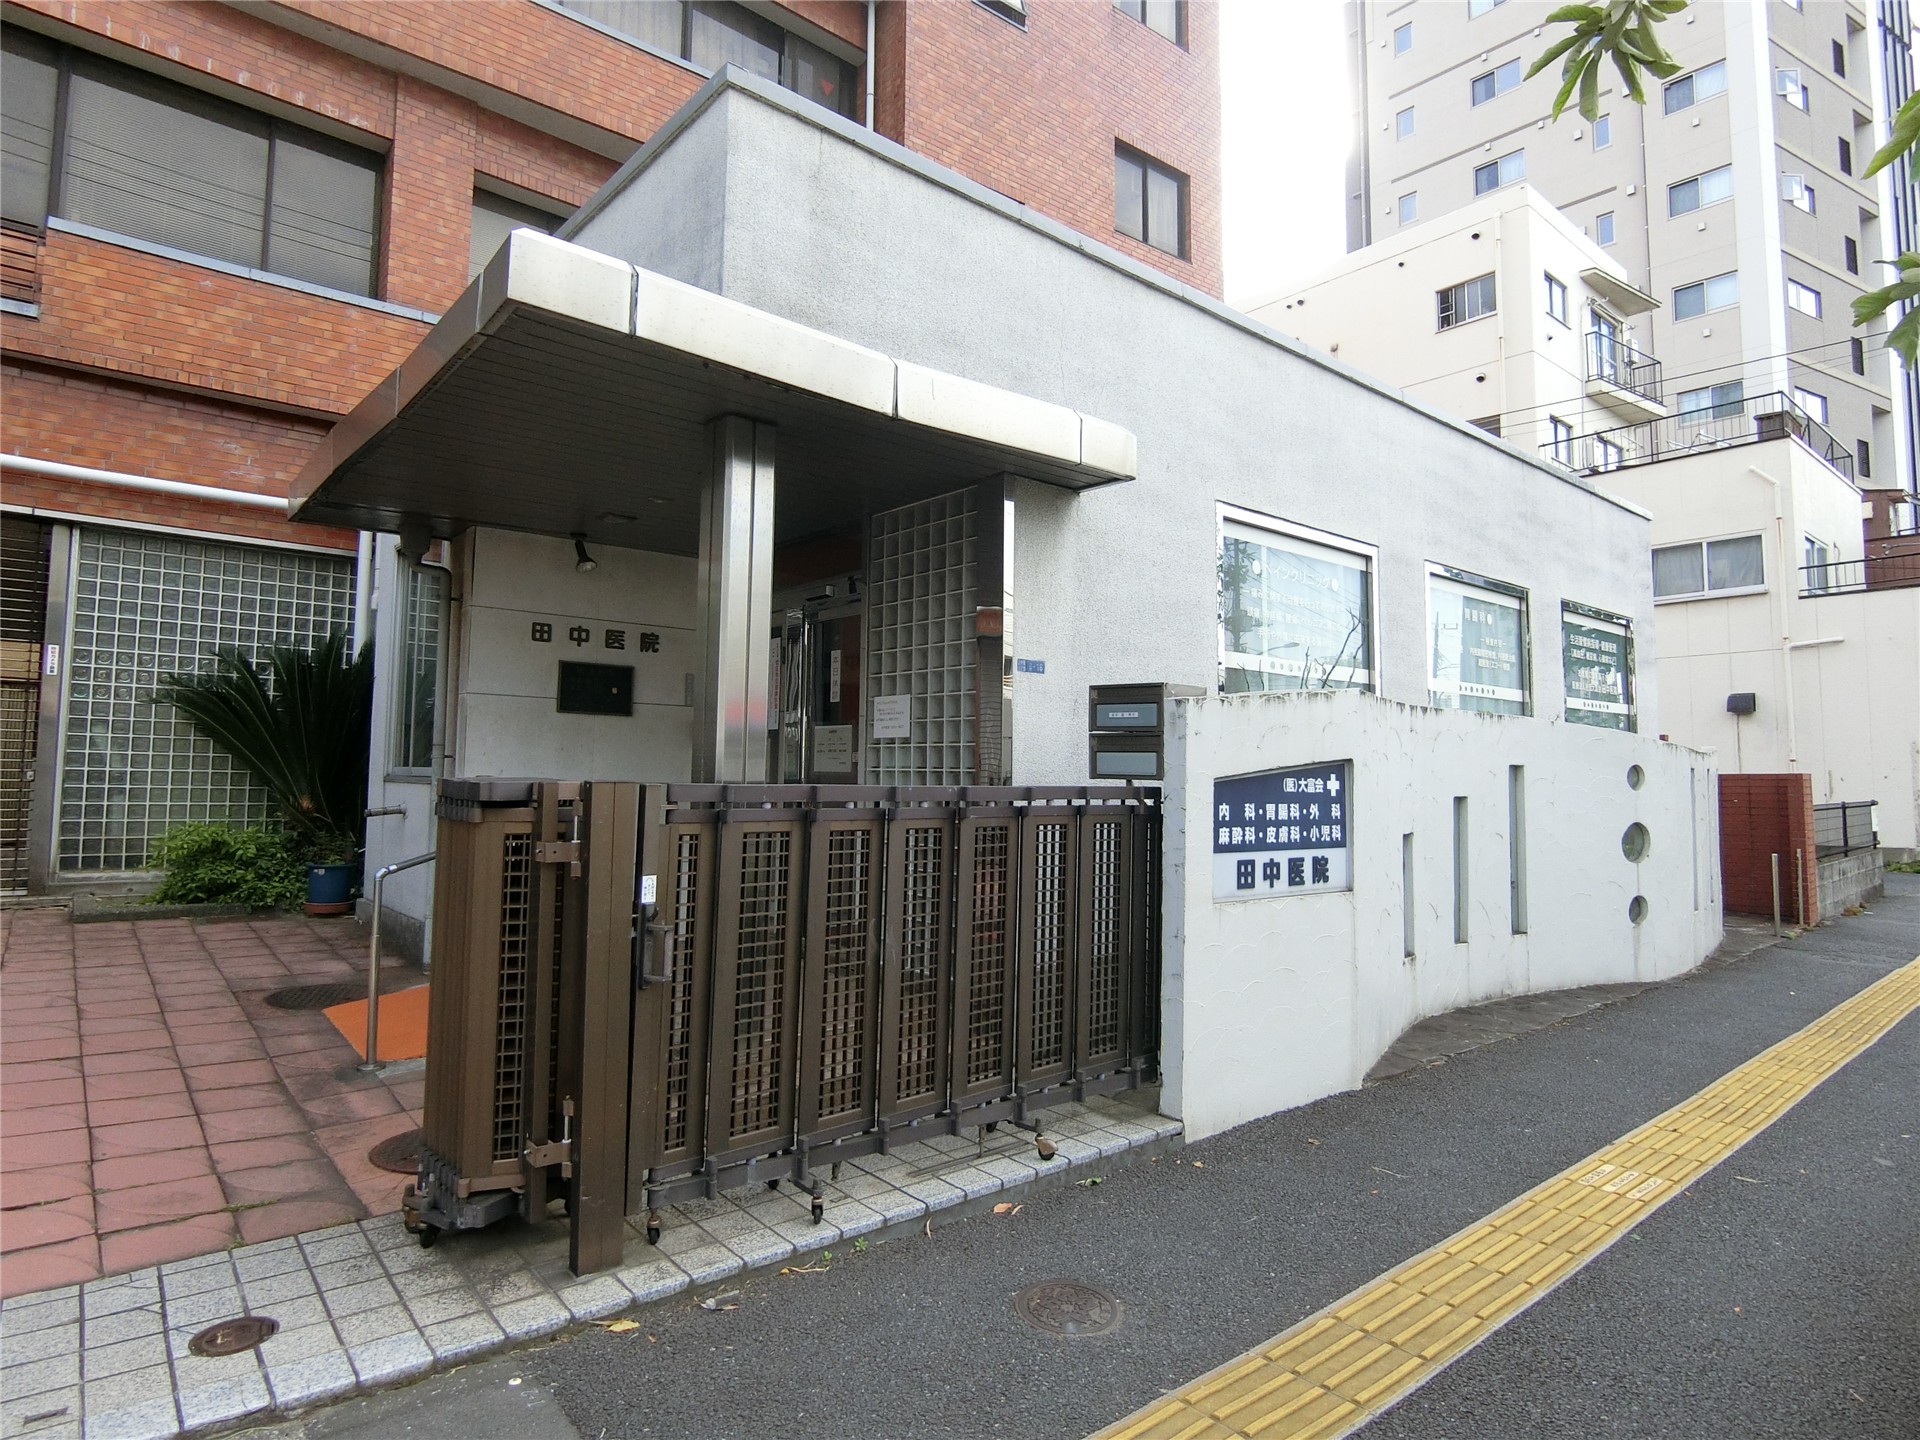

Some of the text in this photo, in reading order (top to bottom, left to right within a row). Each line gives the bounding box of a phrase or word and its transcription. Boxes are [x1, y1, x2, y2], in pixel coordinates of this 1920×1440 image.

[531, 621, 661, 653] 田中医院
[1283, 777, 1324, 793] (医)大富会
[1218, 824, 1342, 846] 麻酔科・皮膚科・小児科
[1236, 855, 1330, 890] 田中医院
